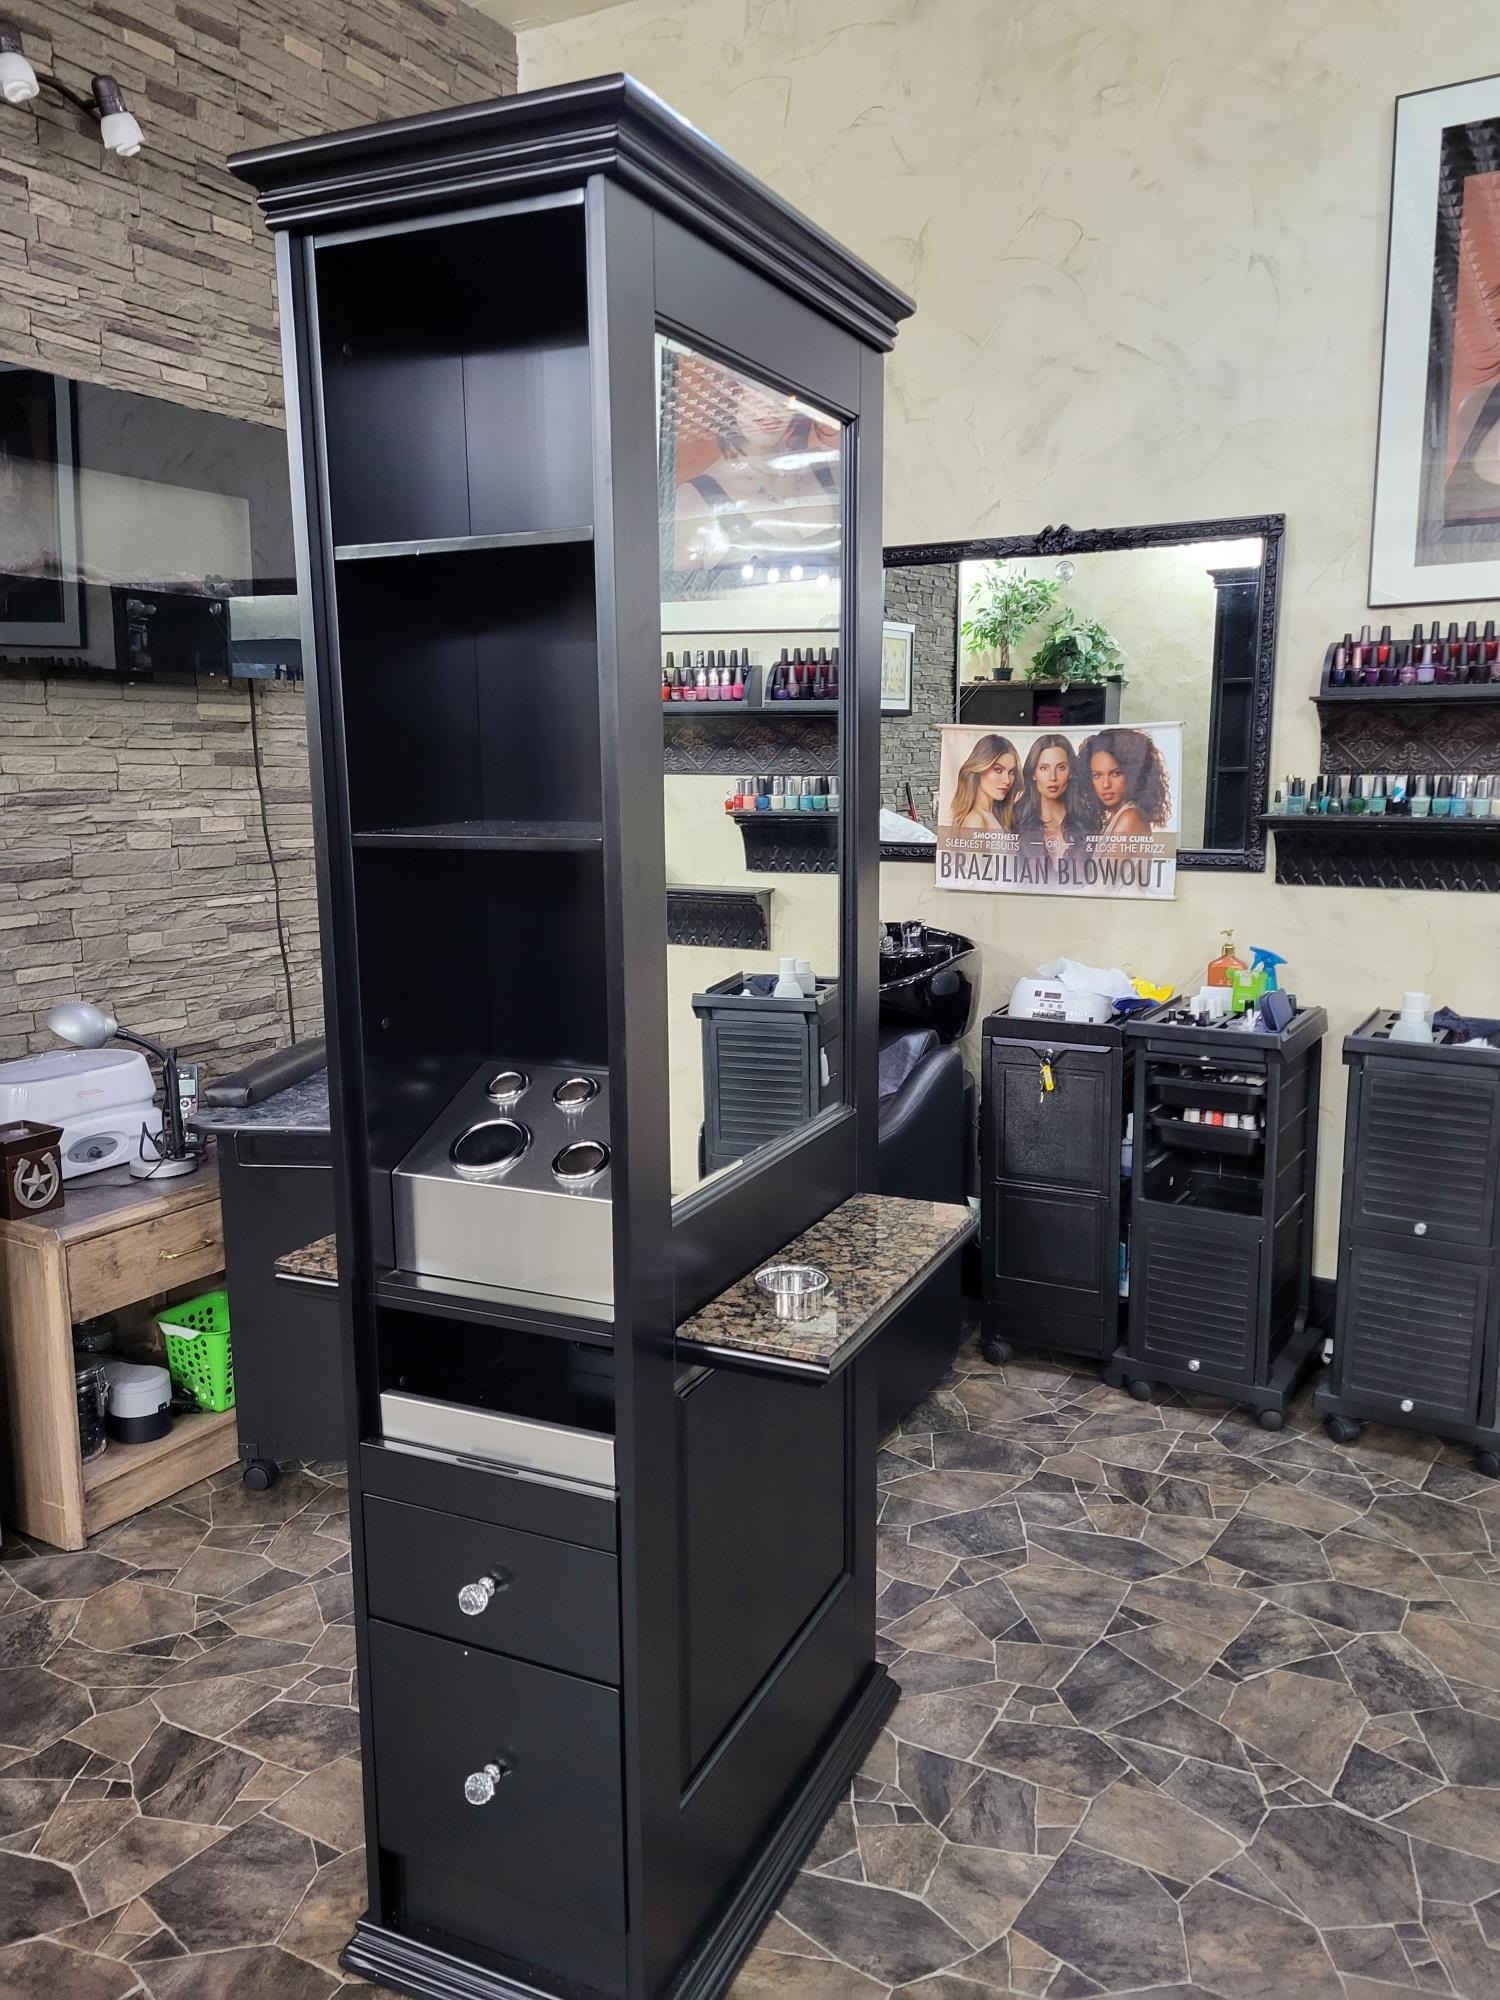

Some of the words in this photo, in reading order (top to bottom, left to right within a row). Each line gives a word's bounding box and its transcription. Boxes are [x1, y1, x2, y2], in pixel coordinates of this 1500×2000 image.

[973, 831, 1020, 841] SMOOTHEST
[1105, 835, 1127, 843] YOUR
[1129, 835, 1154, 843] CURLS
[945, 838, 984, 849] SLEEKEST
[985, 840, 1020, 851] RESULTS
[1046, 840, 1058, 848] OR
[1086, 843, 1093, 853] &
[1095, 843, 1118, 853] LOSE
[1119, 844, 1137, 853] THE
[1140, 844, 1165, 854] FRIZZ
[940, 851, 1048, 885] BRAZILIAN
[1057, 858, 1166, 888] BLOWOUT
